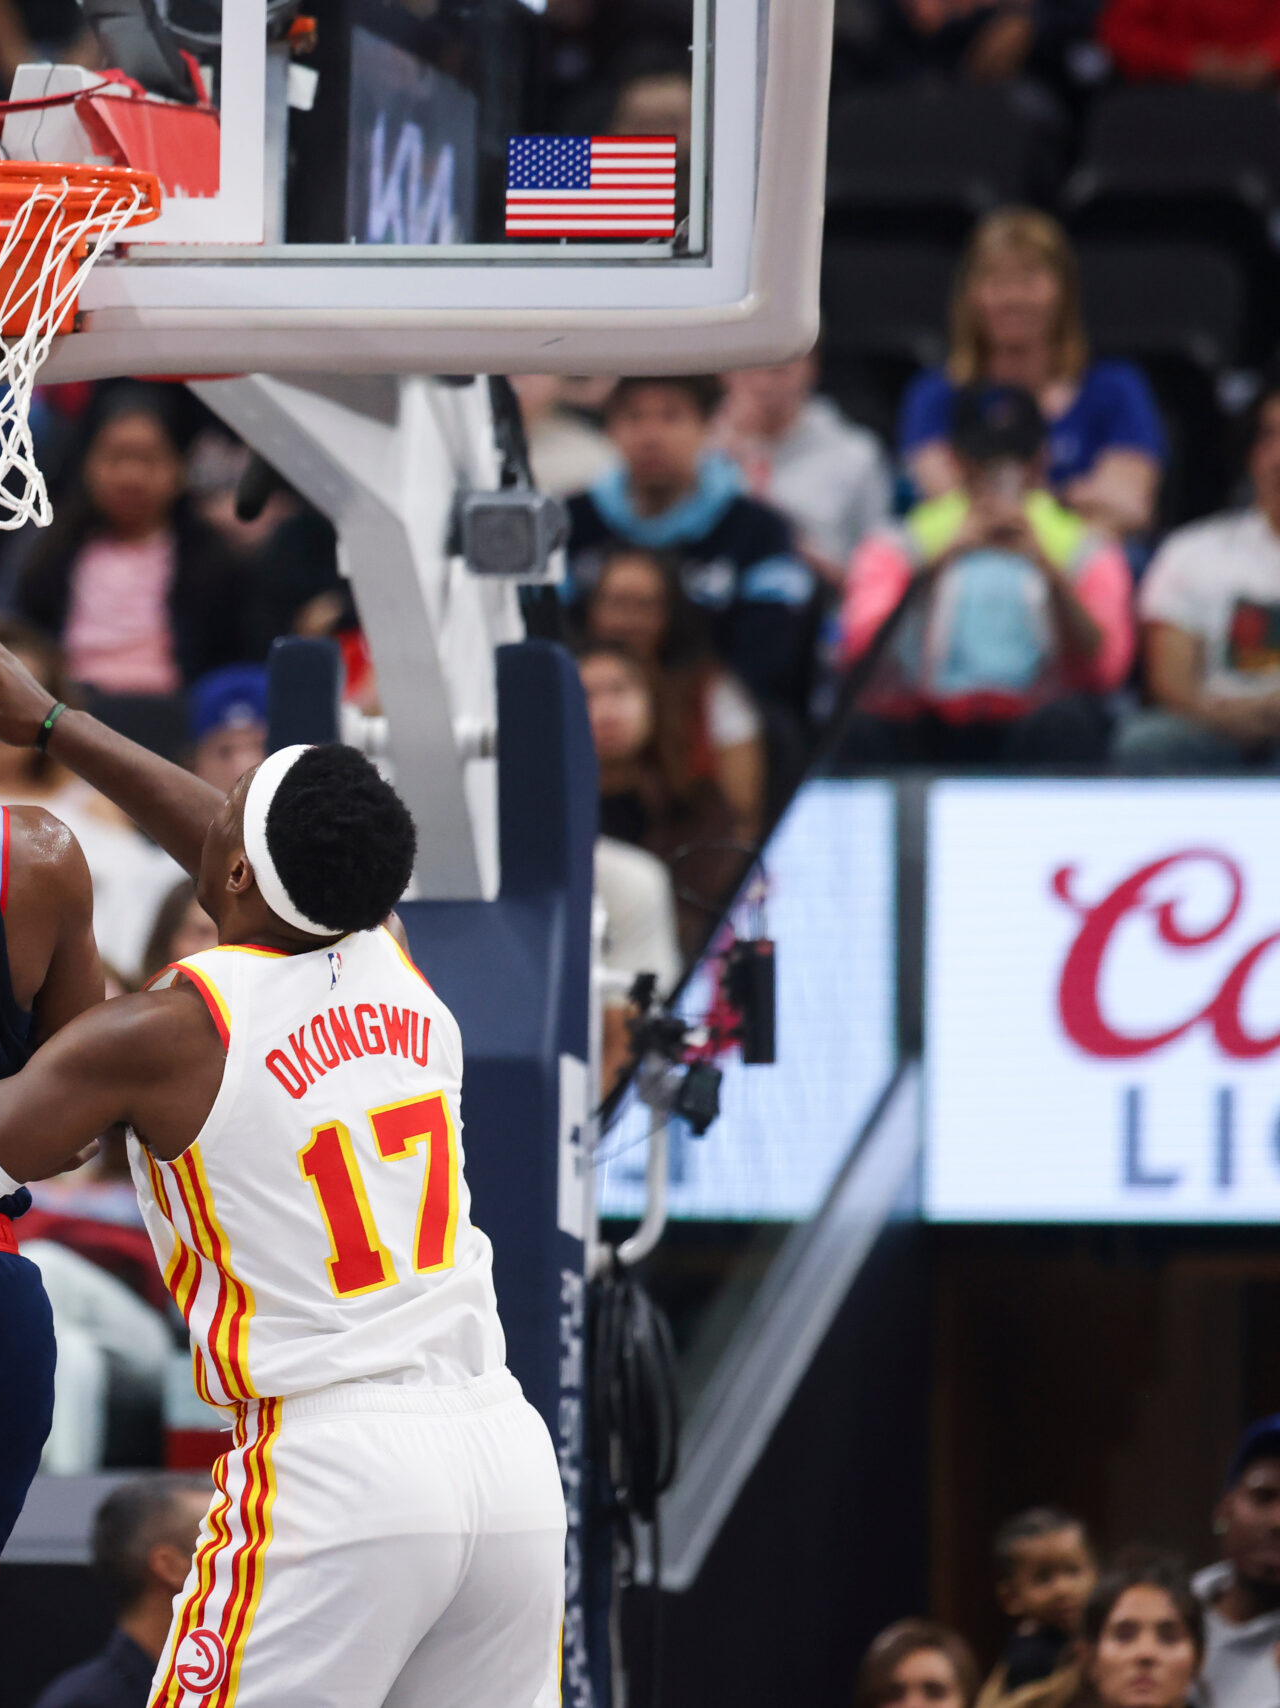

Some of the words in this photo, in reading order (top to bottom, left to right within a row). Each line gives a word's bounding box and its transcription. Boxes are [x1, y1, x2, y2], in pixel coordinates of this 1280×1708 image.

[265, 1003, 432, 1100] OKONGWU
[1124, 1085, 1280, 1188] LI
[296, 1089, 460, 1300] 17
